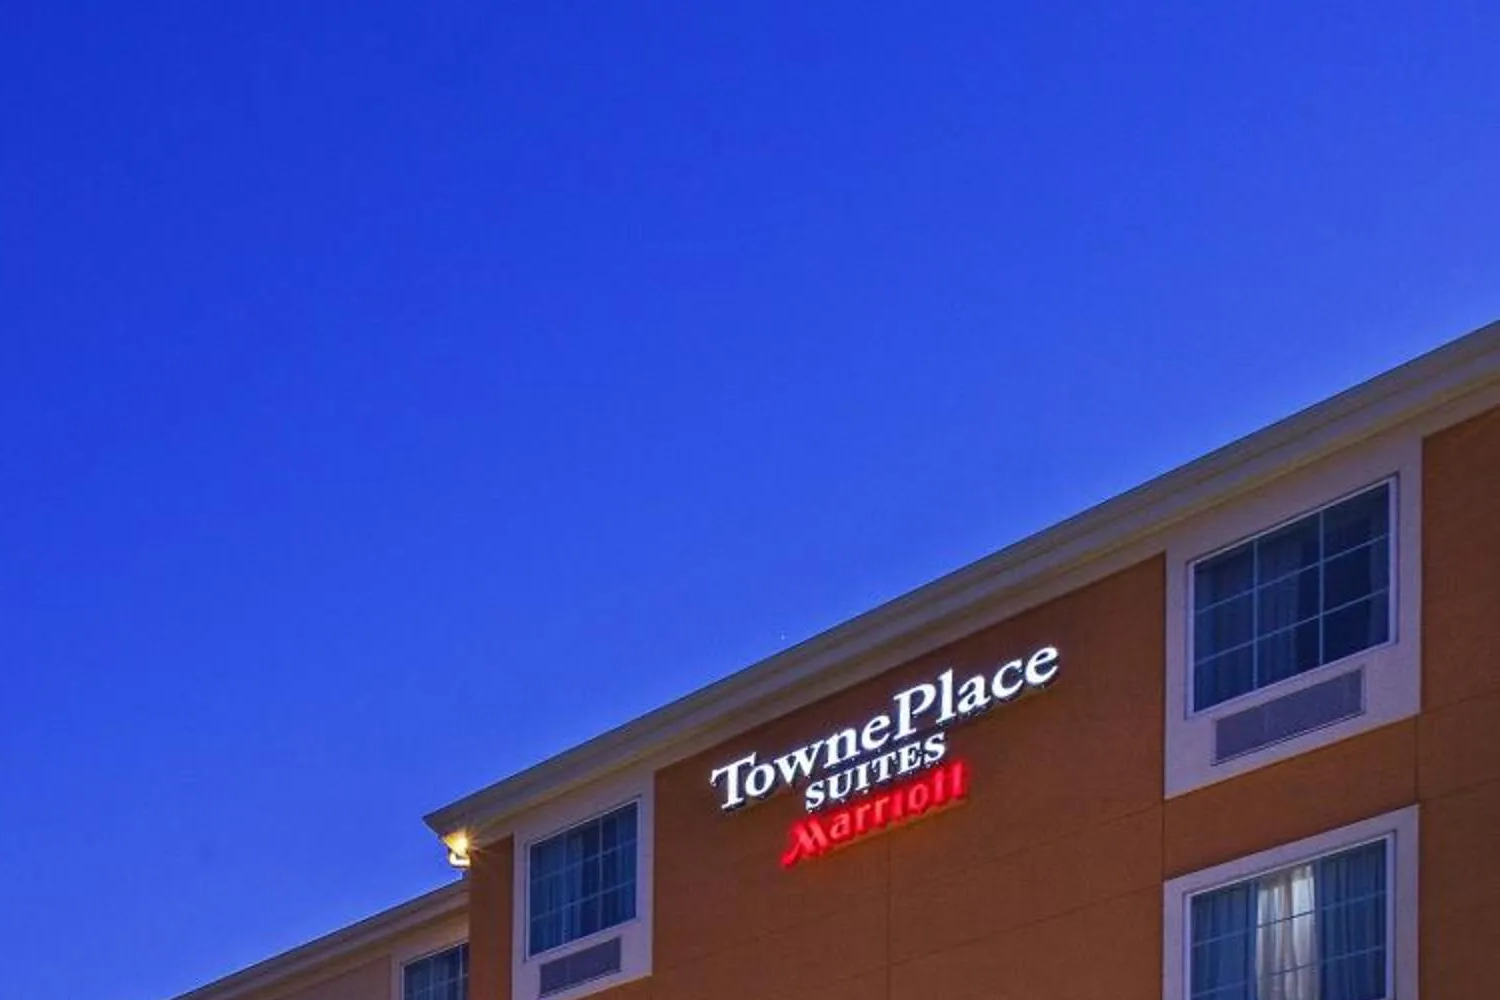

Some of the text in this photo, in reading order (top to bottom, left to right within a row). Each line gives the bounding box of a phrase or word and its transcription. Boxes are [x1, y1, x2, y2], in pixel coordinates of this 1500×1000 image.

[710, 645, 1060, 810] TownePlace
[804, 731, 947, 812] SUITES
[781, 758, 971, 866] Marriott
